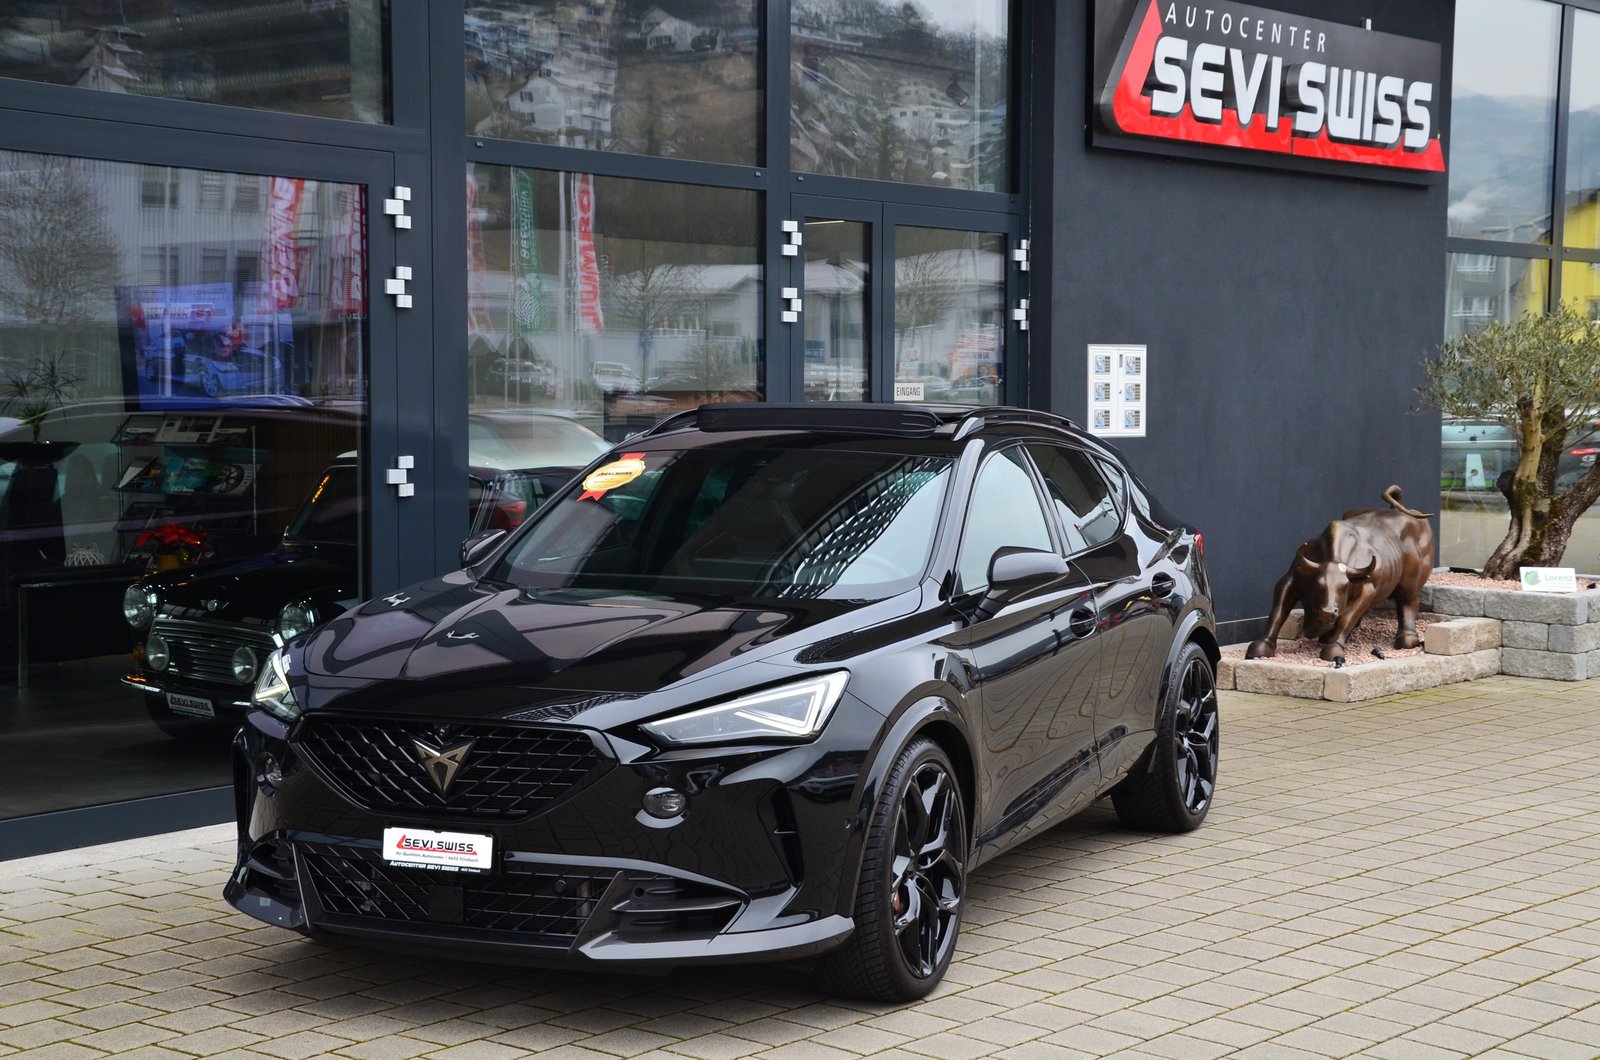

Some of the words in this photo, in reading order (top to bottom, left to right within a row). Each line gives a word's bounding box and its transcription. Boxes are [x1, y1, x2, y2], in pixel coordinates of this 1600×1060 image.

[1165, 2, 1326, 53] AUTOCENTER
[1152, 36, 1283, 128] SEVI
[1296, 61, 1432, 148] SWISS
[577, 188, 604, 331] JUMBO
[896, 386, 921, 397] EINGANG
[1544, 574, 1573, 582] Lorenz
[404, 838, 434, 849] SEVI
[437, 841, 474, 853] SWISS
[389, 860, 427, 869] AUTOCENTER
